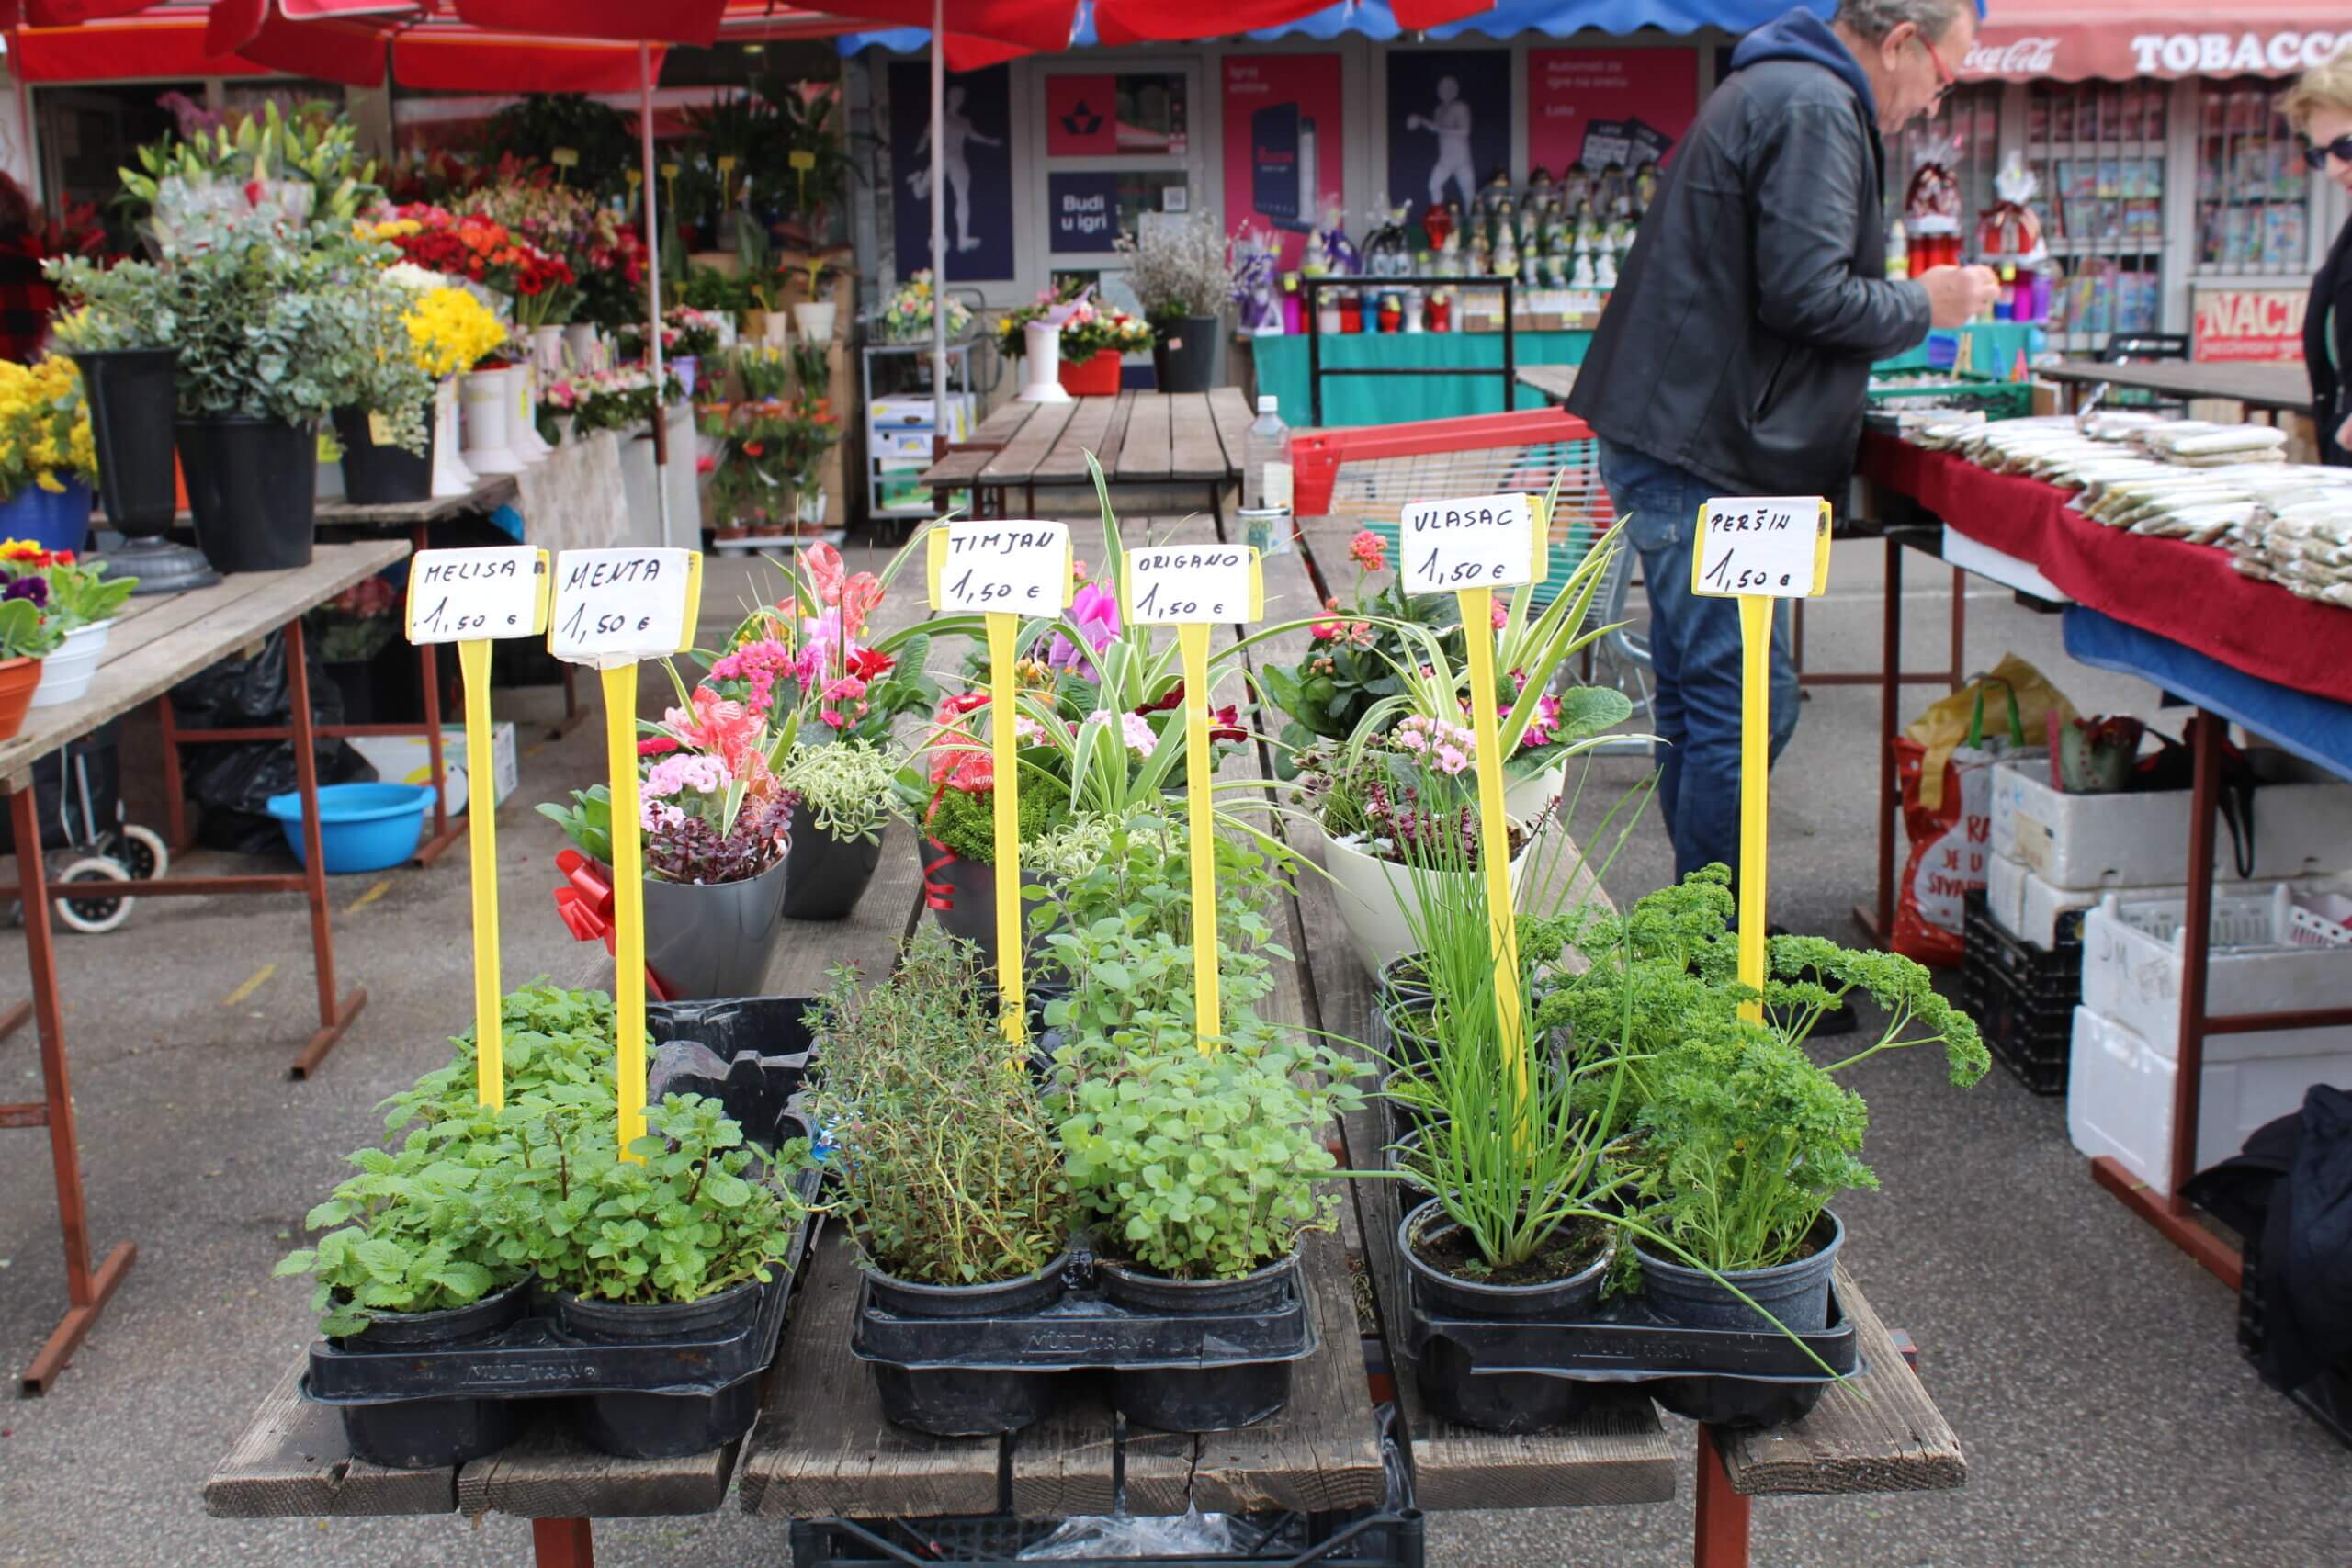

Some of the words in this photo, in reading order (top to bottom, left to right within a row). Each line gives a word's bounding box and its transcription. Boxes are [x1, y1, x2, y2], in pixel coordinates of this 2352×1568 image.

[2130, 30, 2352, 73] TOBACC
[1063, 194, 1104, 212] Budi
[1061, 217, 1073, 231] u
[1077, 213, 1107, 233] igri
[2203, 291, 2302, 337] NACI
[1414, 509, 1513, 532] VLASAC
[1710, 508, 1791, 533] PERŠIN
[951, 531, 1055, 554] TIMJAN
[424, 560, 516, 583] MELISA
[564, 558, 661, 592] MENTA
[1138, 553, 1239, 572] ORIGANO
[1417, 547, 1482, 585] 1,50
[1491, 564, 1506, 580] €
[1705, 549, 1767, 591] 1,50
[950, 569, 1012, 604] 1,50
[1026, 586, 1040, 599] €
[1136, 583, 1198, 618] 1,50
[1213, 603, 1224, 615] €
[424, 596, 485, 632] 1,50
[561, 602, 625, 644] 1,50
[637, 616, 650, 631] €
[1968, 814, 1990, 843] RA
